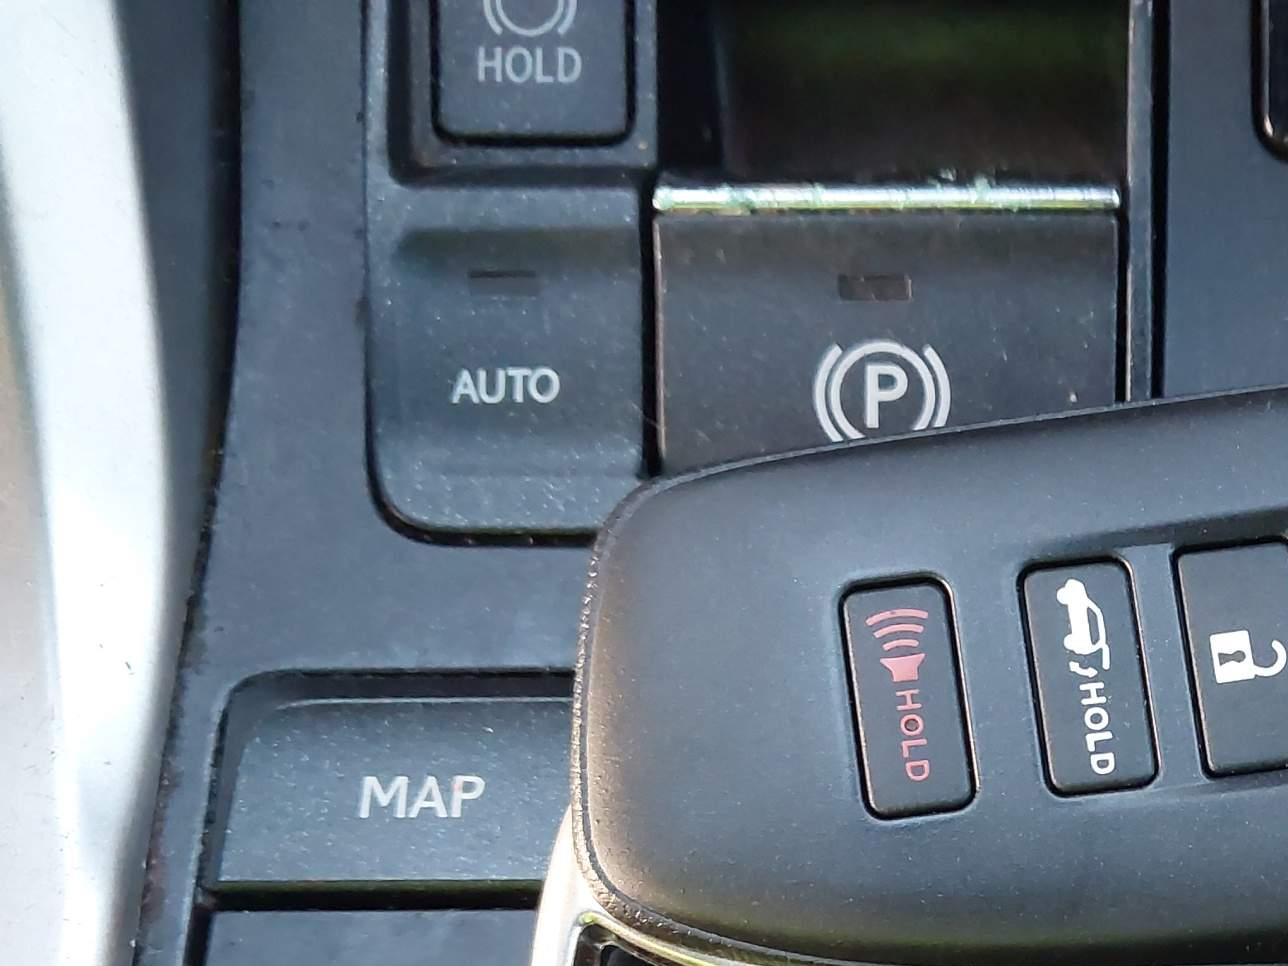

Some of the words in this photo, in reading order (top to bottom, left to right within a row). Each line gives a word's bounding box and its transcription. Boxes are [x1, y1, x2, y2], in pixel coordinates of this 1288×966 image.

[477, 46, 582, 84] HOLD
[452, 367, 560, 404] AUTO
[865, 364, 908, 428] P
[895, 688, 930, 782] HOLD
[1079, 681, 1115, 776] HOLD
[359, 775, 486, 819] MAP
